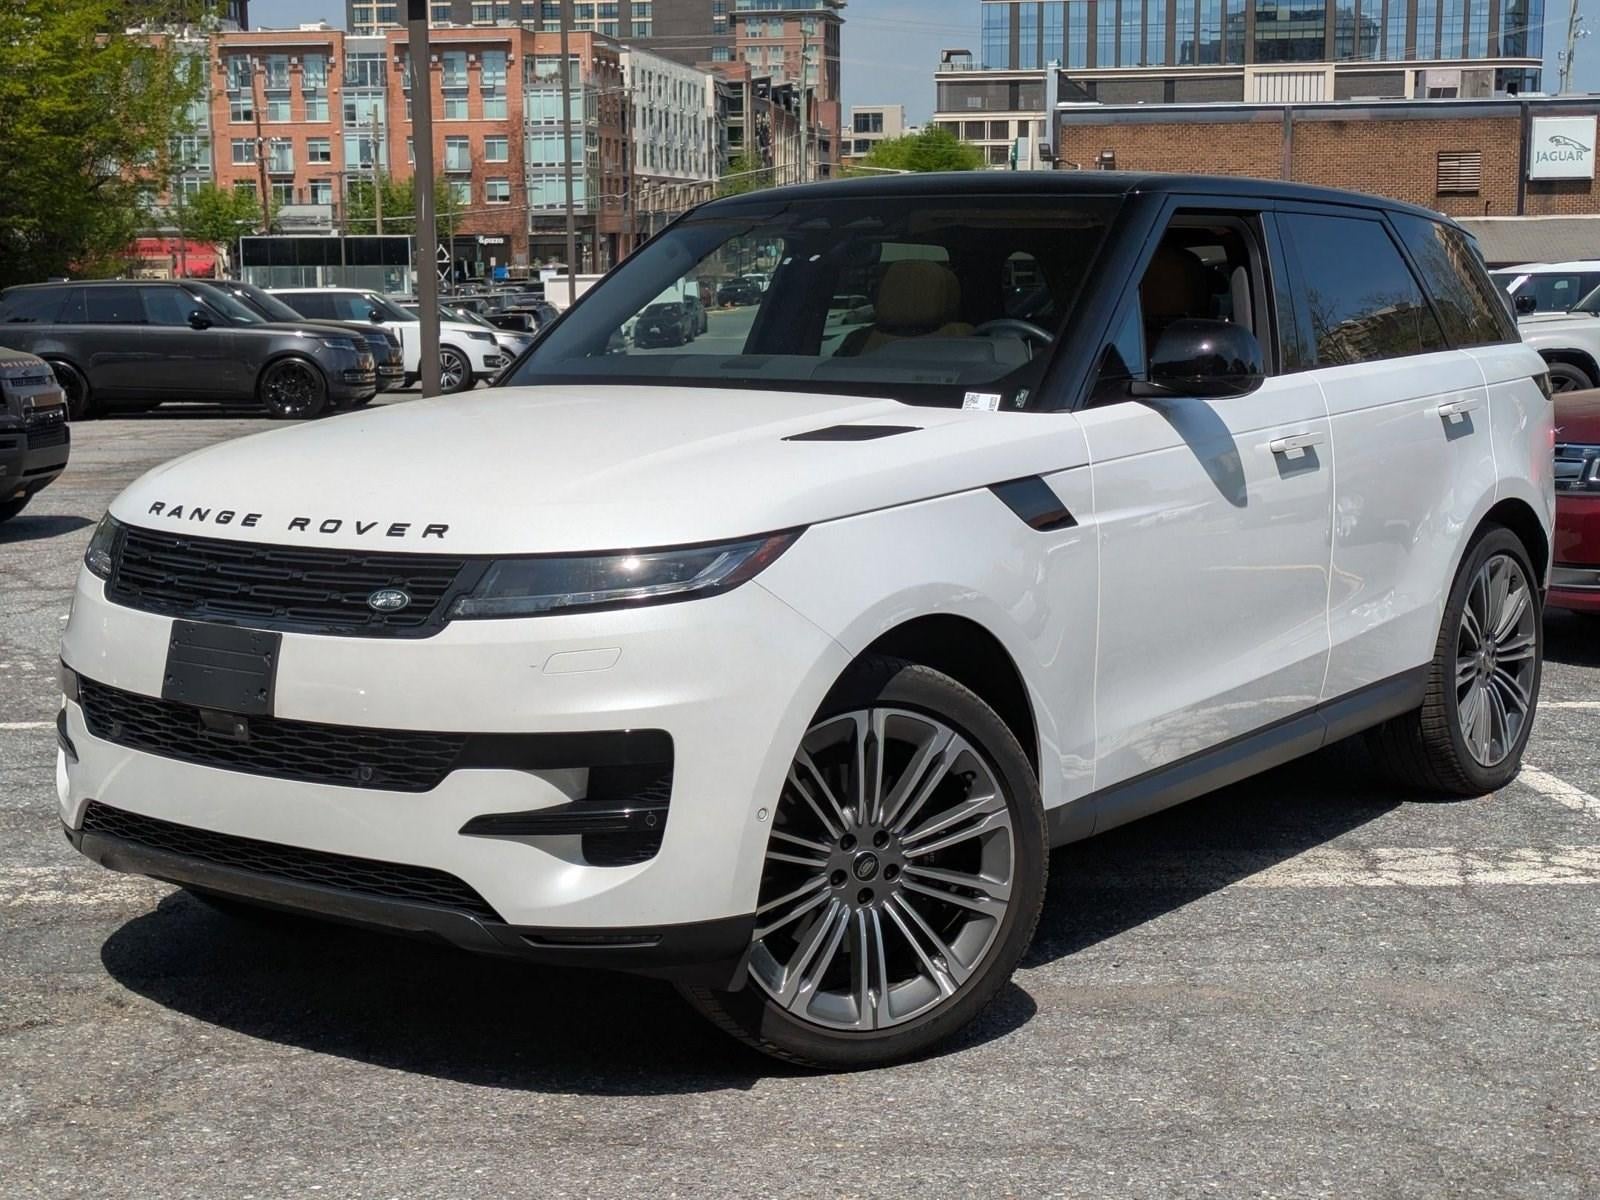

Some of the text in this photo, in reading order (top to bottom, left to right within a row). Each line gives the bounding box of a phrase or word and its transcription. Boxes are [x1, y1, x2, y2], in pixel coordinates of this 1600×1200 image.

[1535, 150, 1584, 164] JAGUAR
[148, 501, 450, 538] RANGE ROVER
